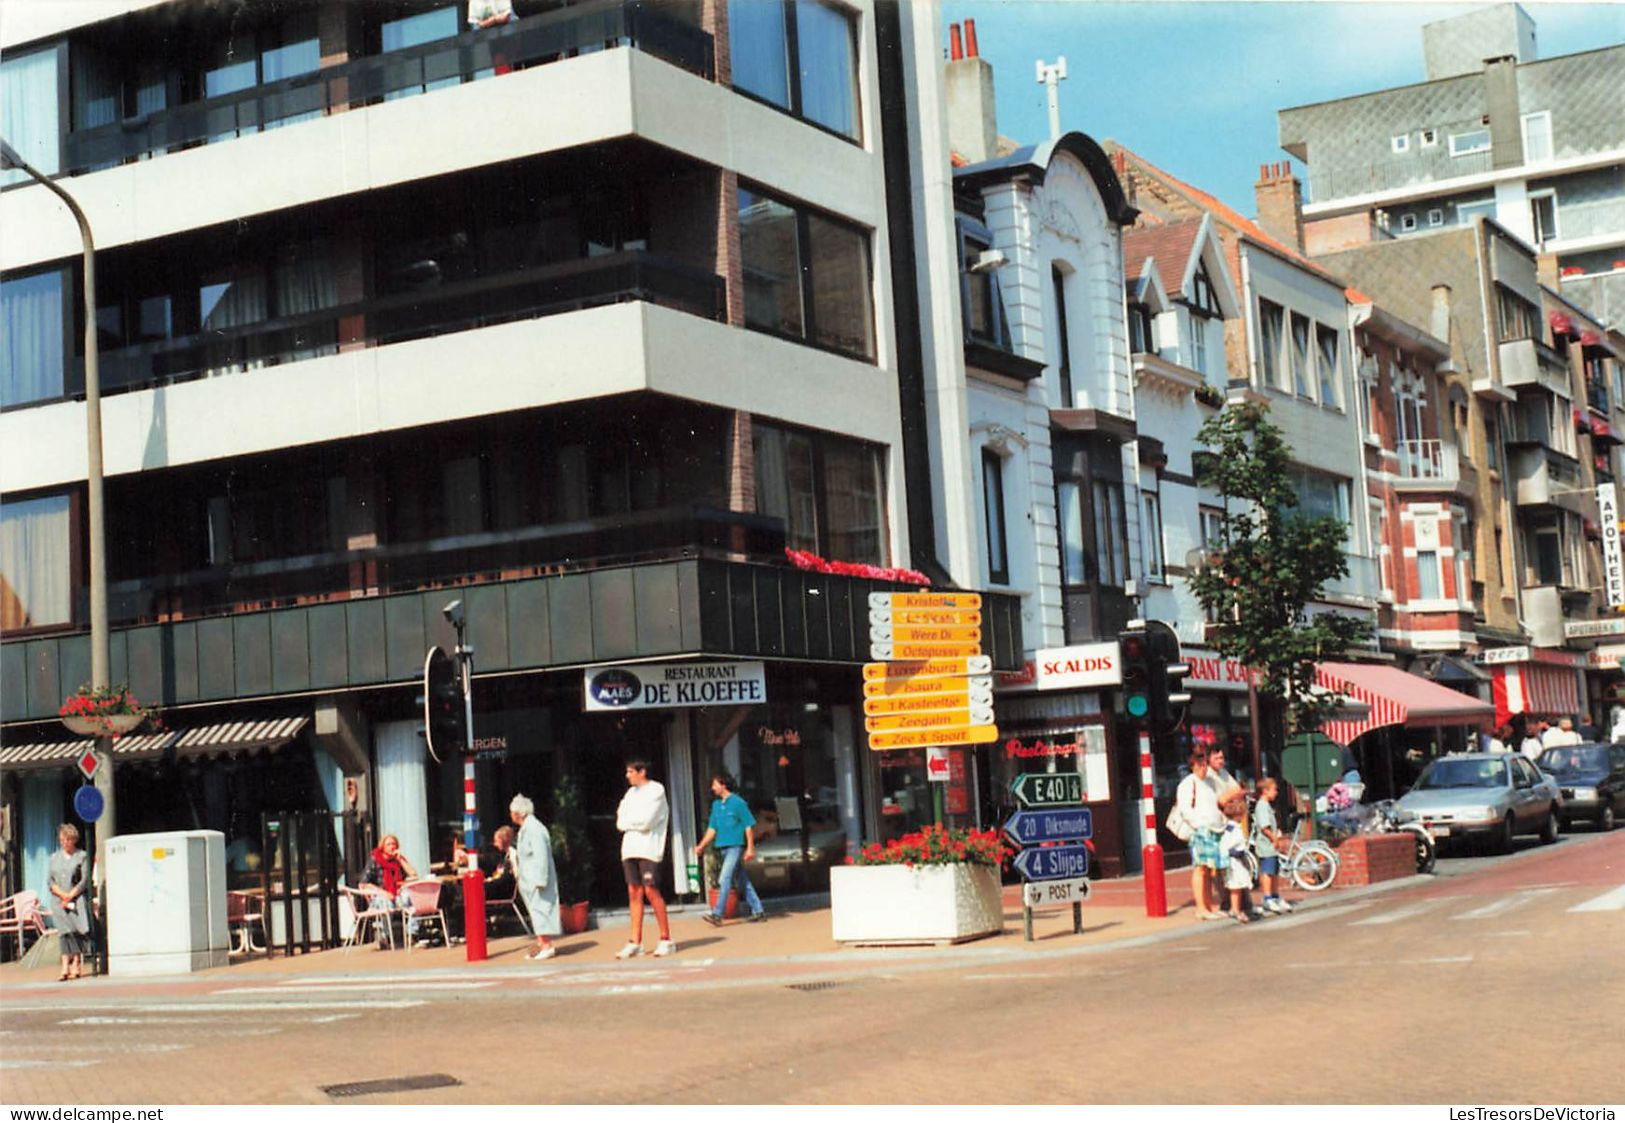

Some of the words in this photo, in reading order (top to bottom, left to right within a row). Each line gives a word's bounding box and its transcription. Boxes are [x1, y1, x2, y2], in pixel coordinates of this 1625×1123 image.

[1604, 501, 1621, 603] APOTHEEK
[911, 629, 938, 641] Were
[665, 666, 737, 681] RESTAURANT
[886, 663, 958, 677] Luxemburg
[1044, 656, 1112, 676] SCALDIS
[1181, 655, 1220, 681] RANT
[597, 686, 633, 699] MAES
[645, 683, 671, 704] DE
[676, 680, 761, 703] KLOEFFE
[898, 698, 960, 710] Kasteeltje
[892, 734, 915, 745] Zee
[919, 732, 927, 743] &
[932, 730, 967, 743] Sport
[1035, 779, 1046, 801] E
[1047, 778, 1064, 800] 40
[1024, 818, 1037, 837] 20
[1033, 853, 1043, 875] 4
[1049, 850, 1084, 877] Slijpe
[1049, 884, 1072, 900] POST
